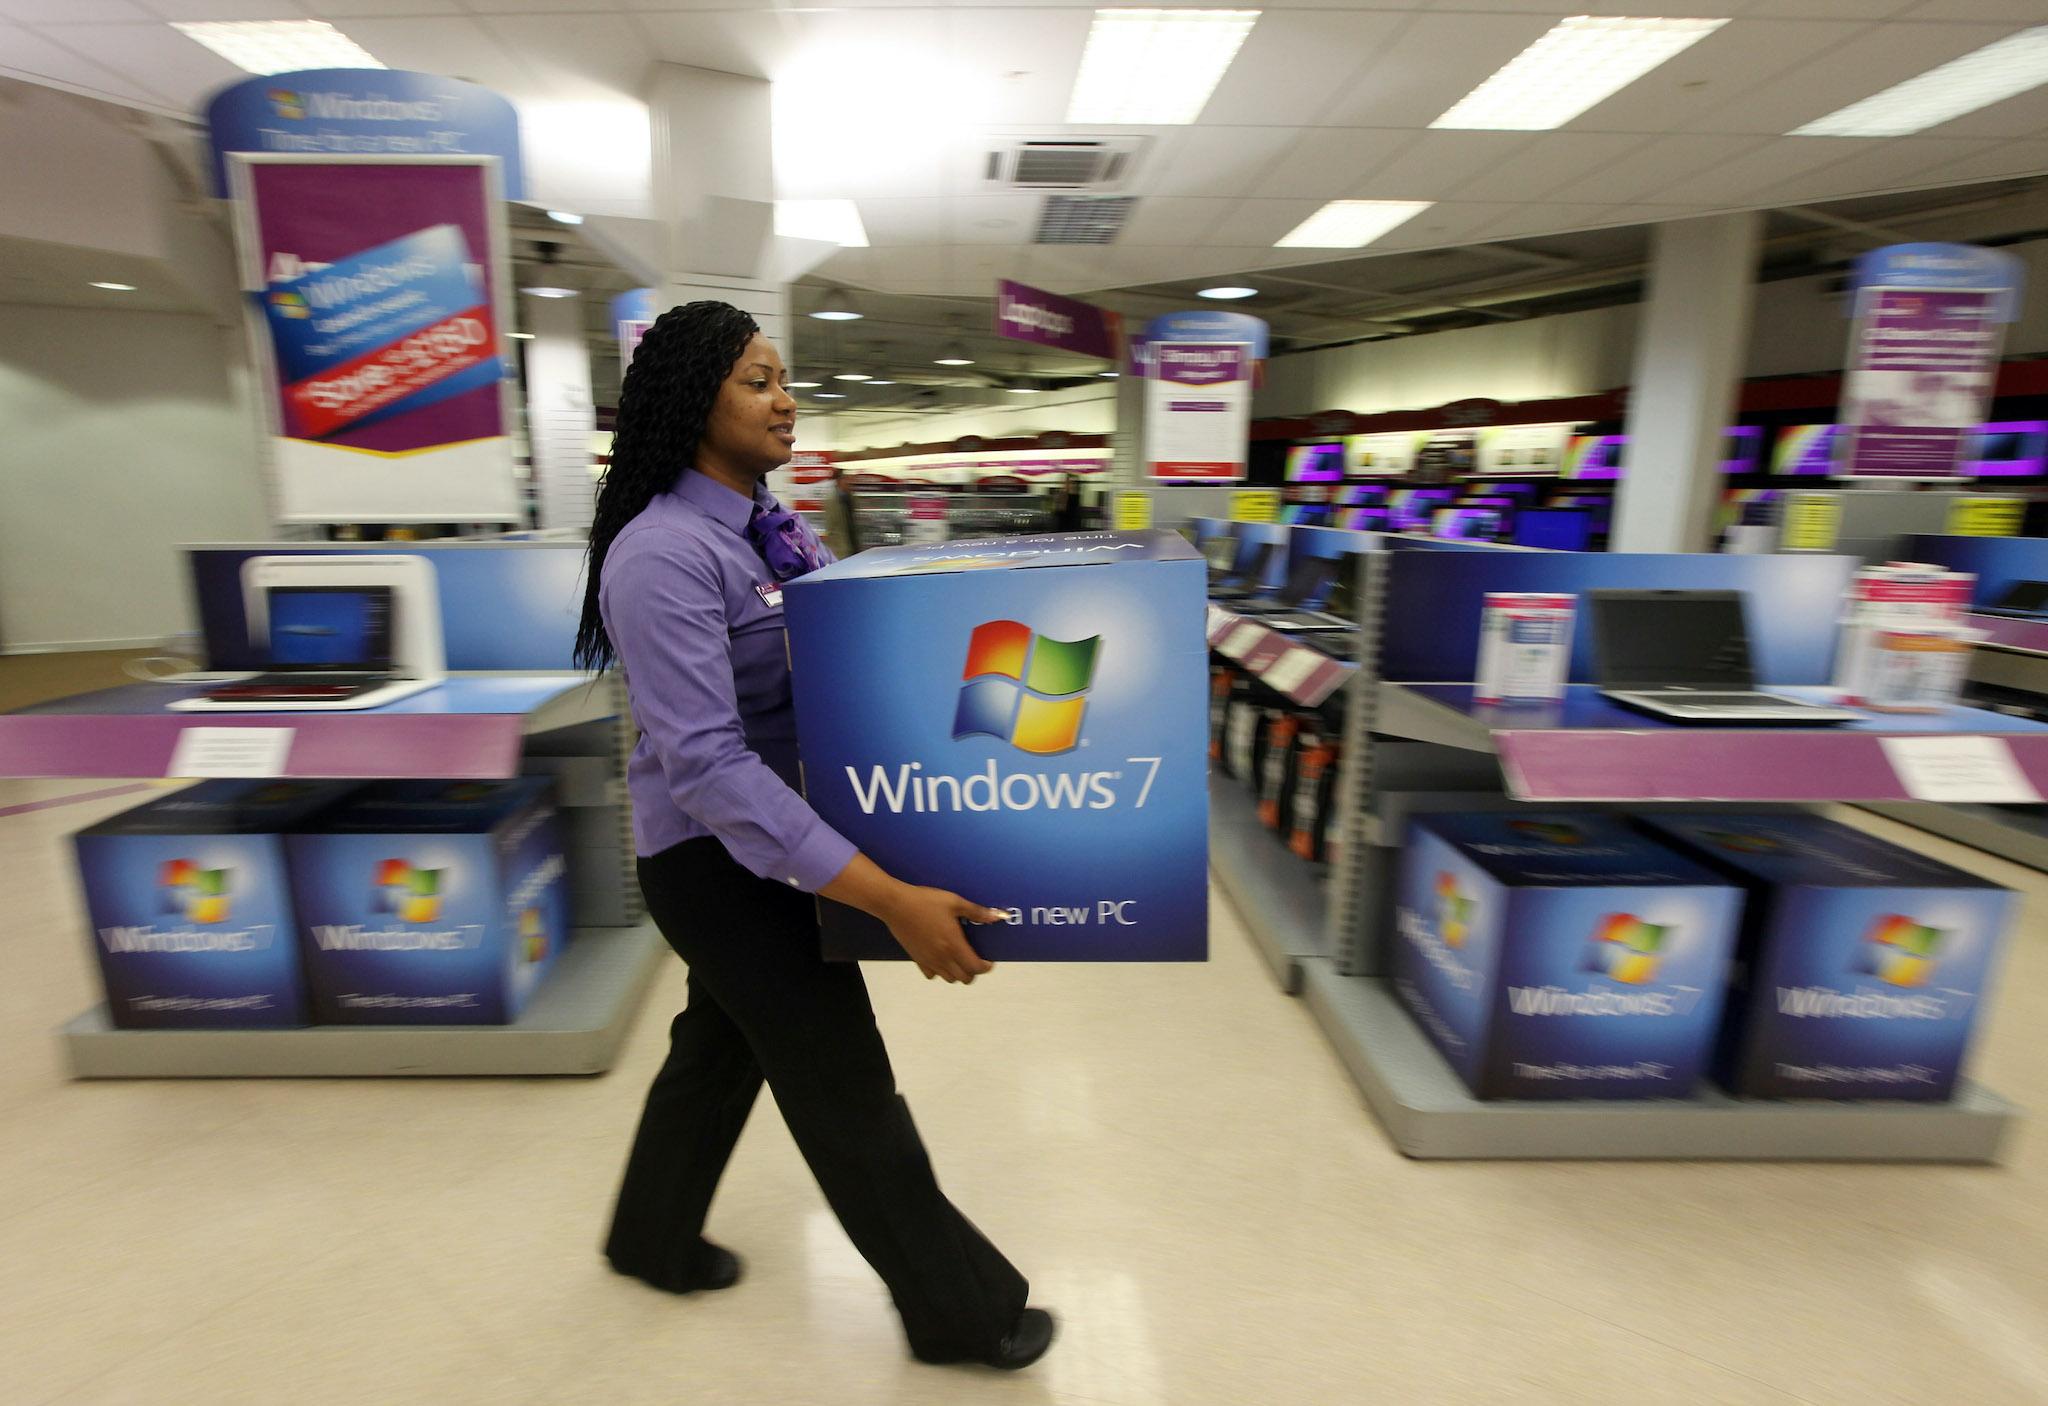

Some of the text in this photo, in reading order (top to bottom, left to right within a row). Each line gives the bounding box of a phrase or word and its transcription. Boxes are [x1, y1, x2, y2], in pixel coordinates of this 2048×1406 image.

[911, 543, 1145, 561] Windows
[845, 757, 1163, 814] Windows 7
[1031, 907, 1090, 926] new
[1097, 900, 1138, 926] PC
[99, 925, 257, 953] Windows
[310, 925, 464, 951] Windows
[1508, 985, 1676, 1017] Windows
